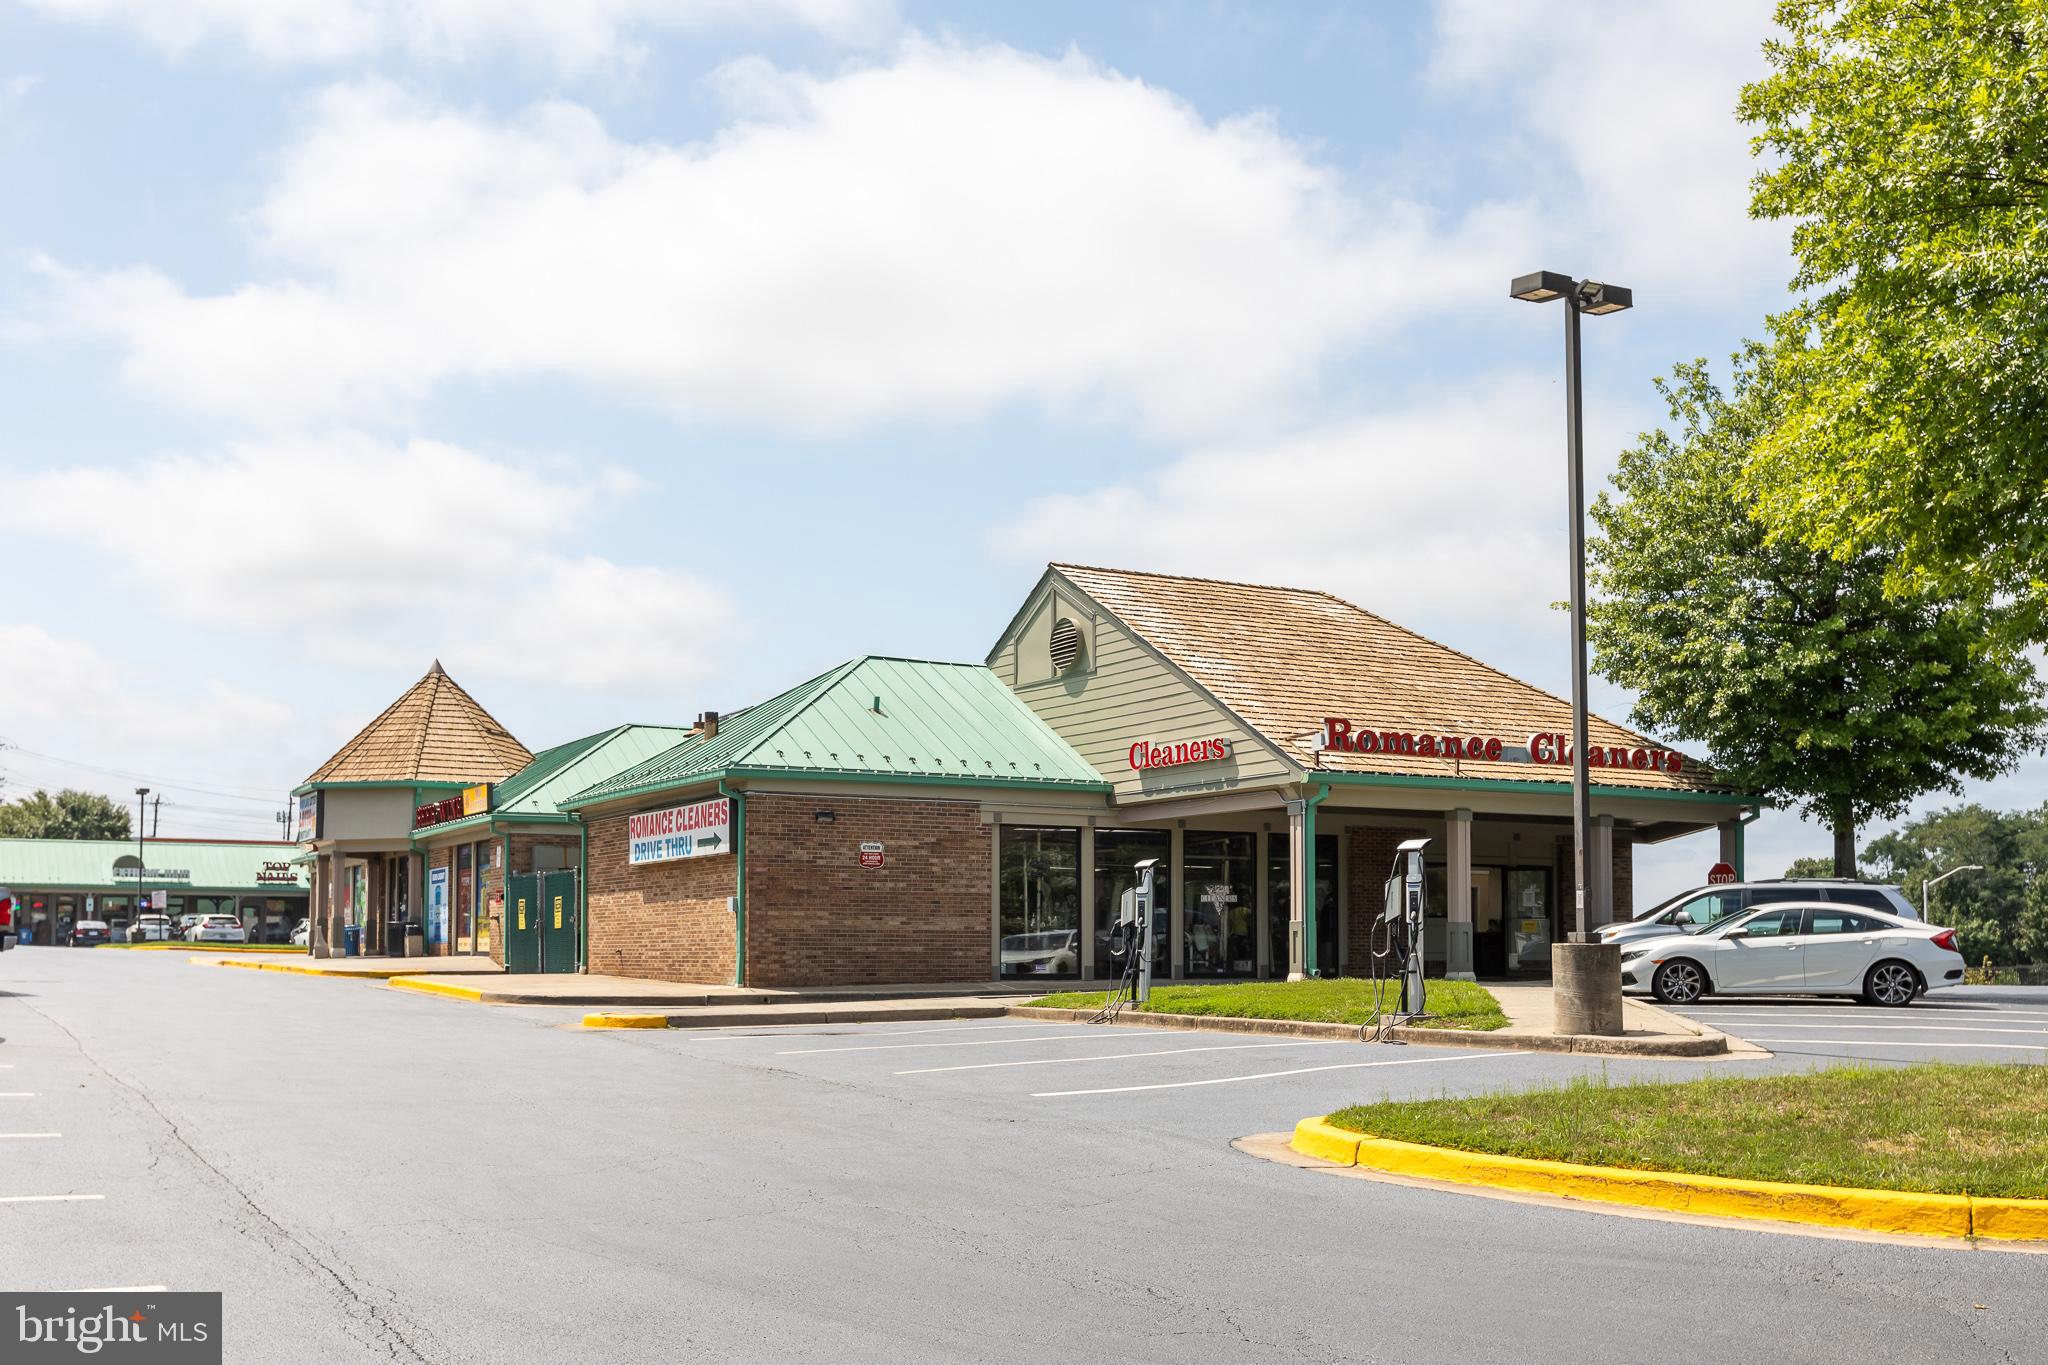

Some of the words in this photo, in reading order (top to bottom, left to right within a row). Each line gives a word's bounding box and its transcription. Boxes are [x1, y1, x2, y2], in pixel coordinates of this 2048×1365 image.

[1128, 737, 1226, 771] Cleaners
[1323, 716, 1504, 761] Romance
[1529, 732, 1683, 773] Claners
[630, 809, 673, 840] ROMANCE
[675, 800, 728, 833] CLEANERS
[634, 837, 663, 862] DRIVE
[665, 835, 692, 857] THRU
[256, 872, 298, 882] NAILS
[263, 861, 291, 872] TOP
[1710, 873, 1735, 885] STOP
